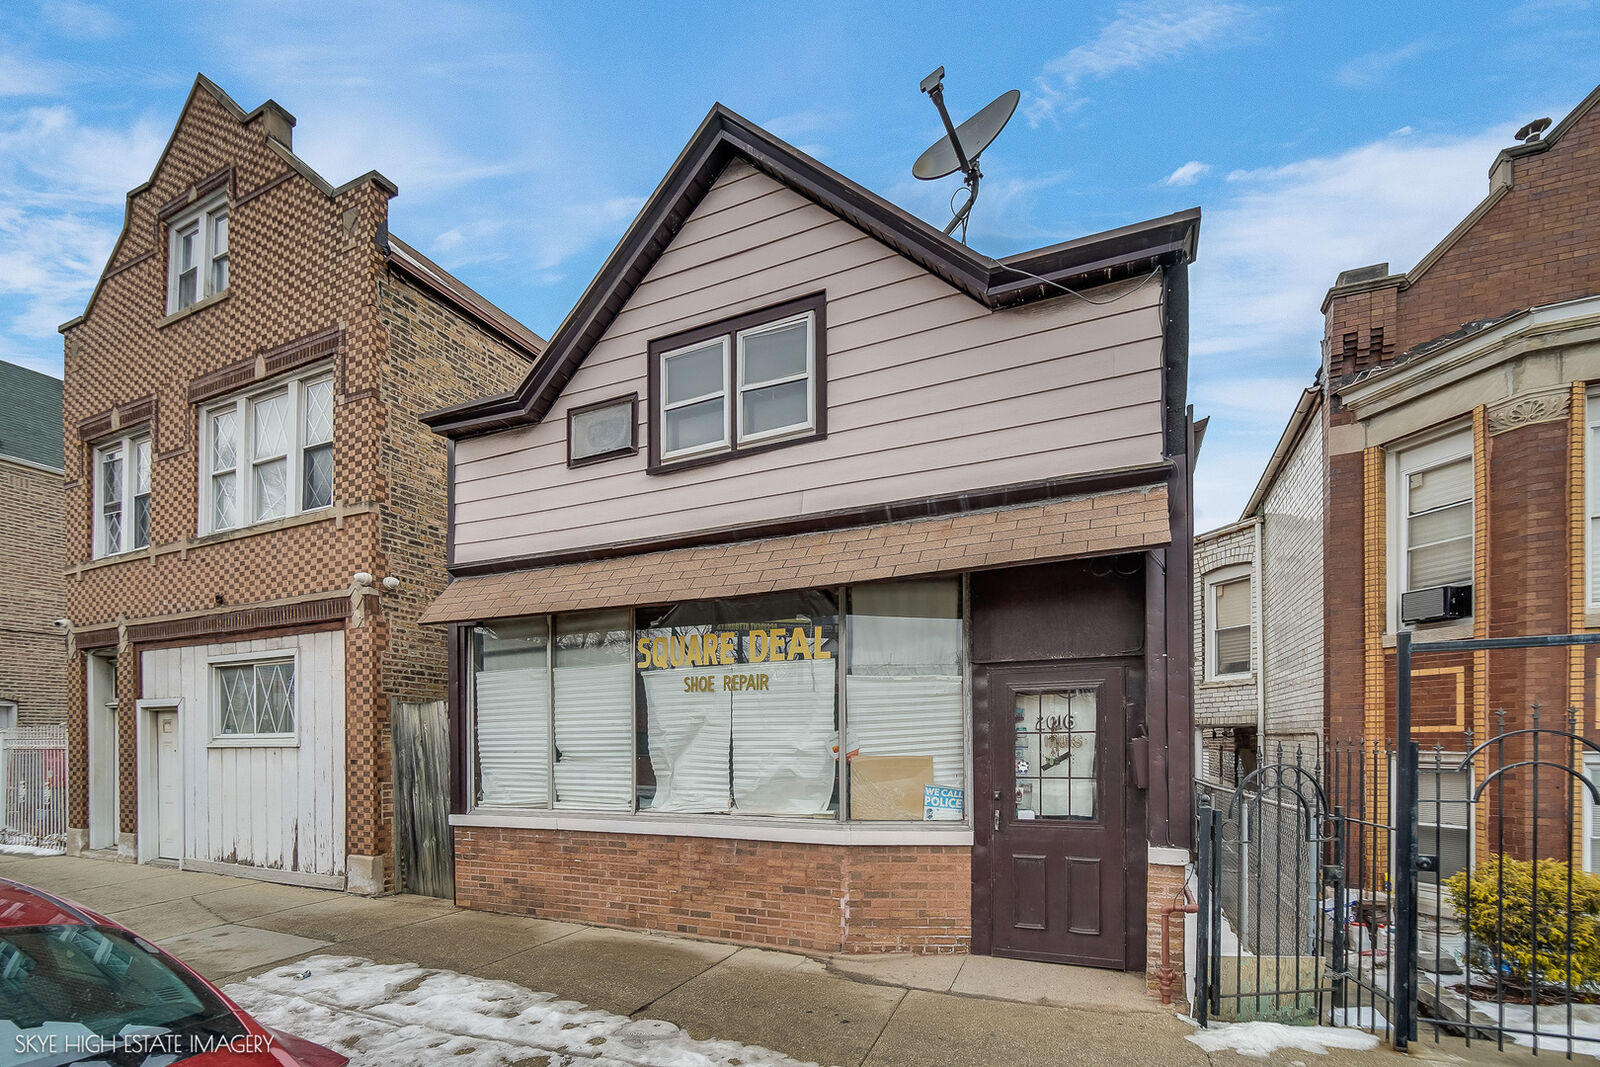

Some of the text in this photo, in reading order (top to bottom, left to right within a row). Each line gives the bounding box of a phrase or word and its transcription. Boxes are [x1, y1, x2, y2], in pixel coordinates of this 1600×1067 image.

[638, 626, 831, 670] SQUARE DEAL
[684, 673, 769, 692] SHOE REPAIR
[925, 787, 940, 797] WE
[925, 796, 962, 808] POLICE
